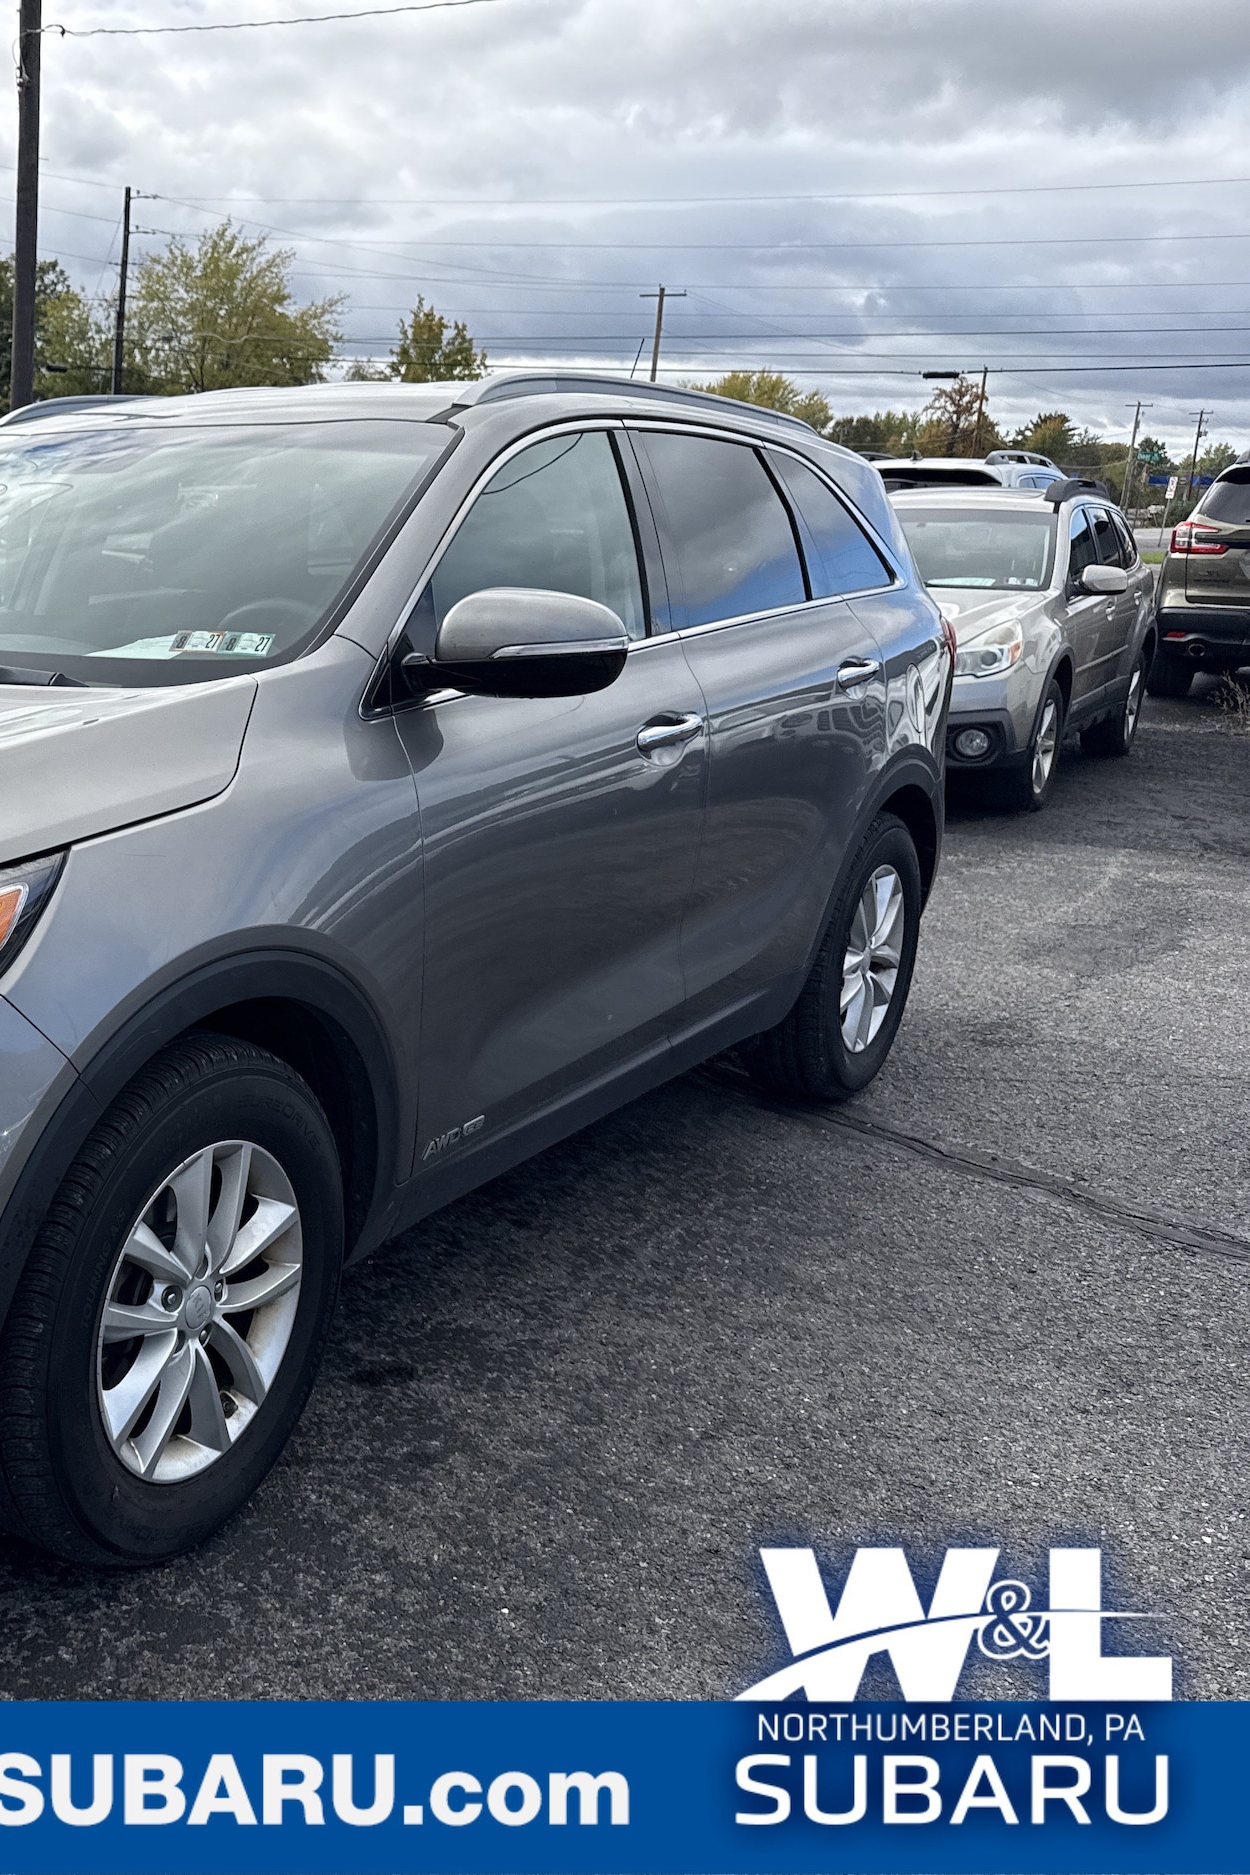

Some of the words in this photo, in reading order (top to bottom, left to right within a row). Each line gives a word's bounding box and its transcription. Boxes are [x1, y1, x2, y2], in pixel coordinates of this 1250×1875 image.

[205, 634, 220, 649] 27
[254, 636, 270, 652] 27
[421, 1127, 461, 1161] AWD
